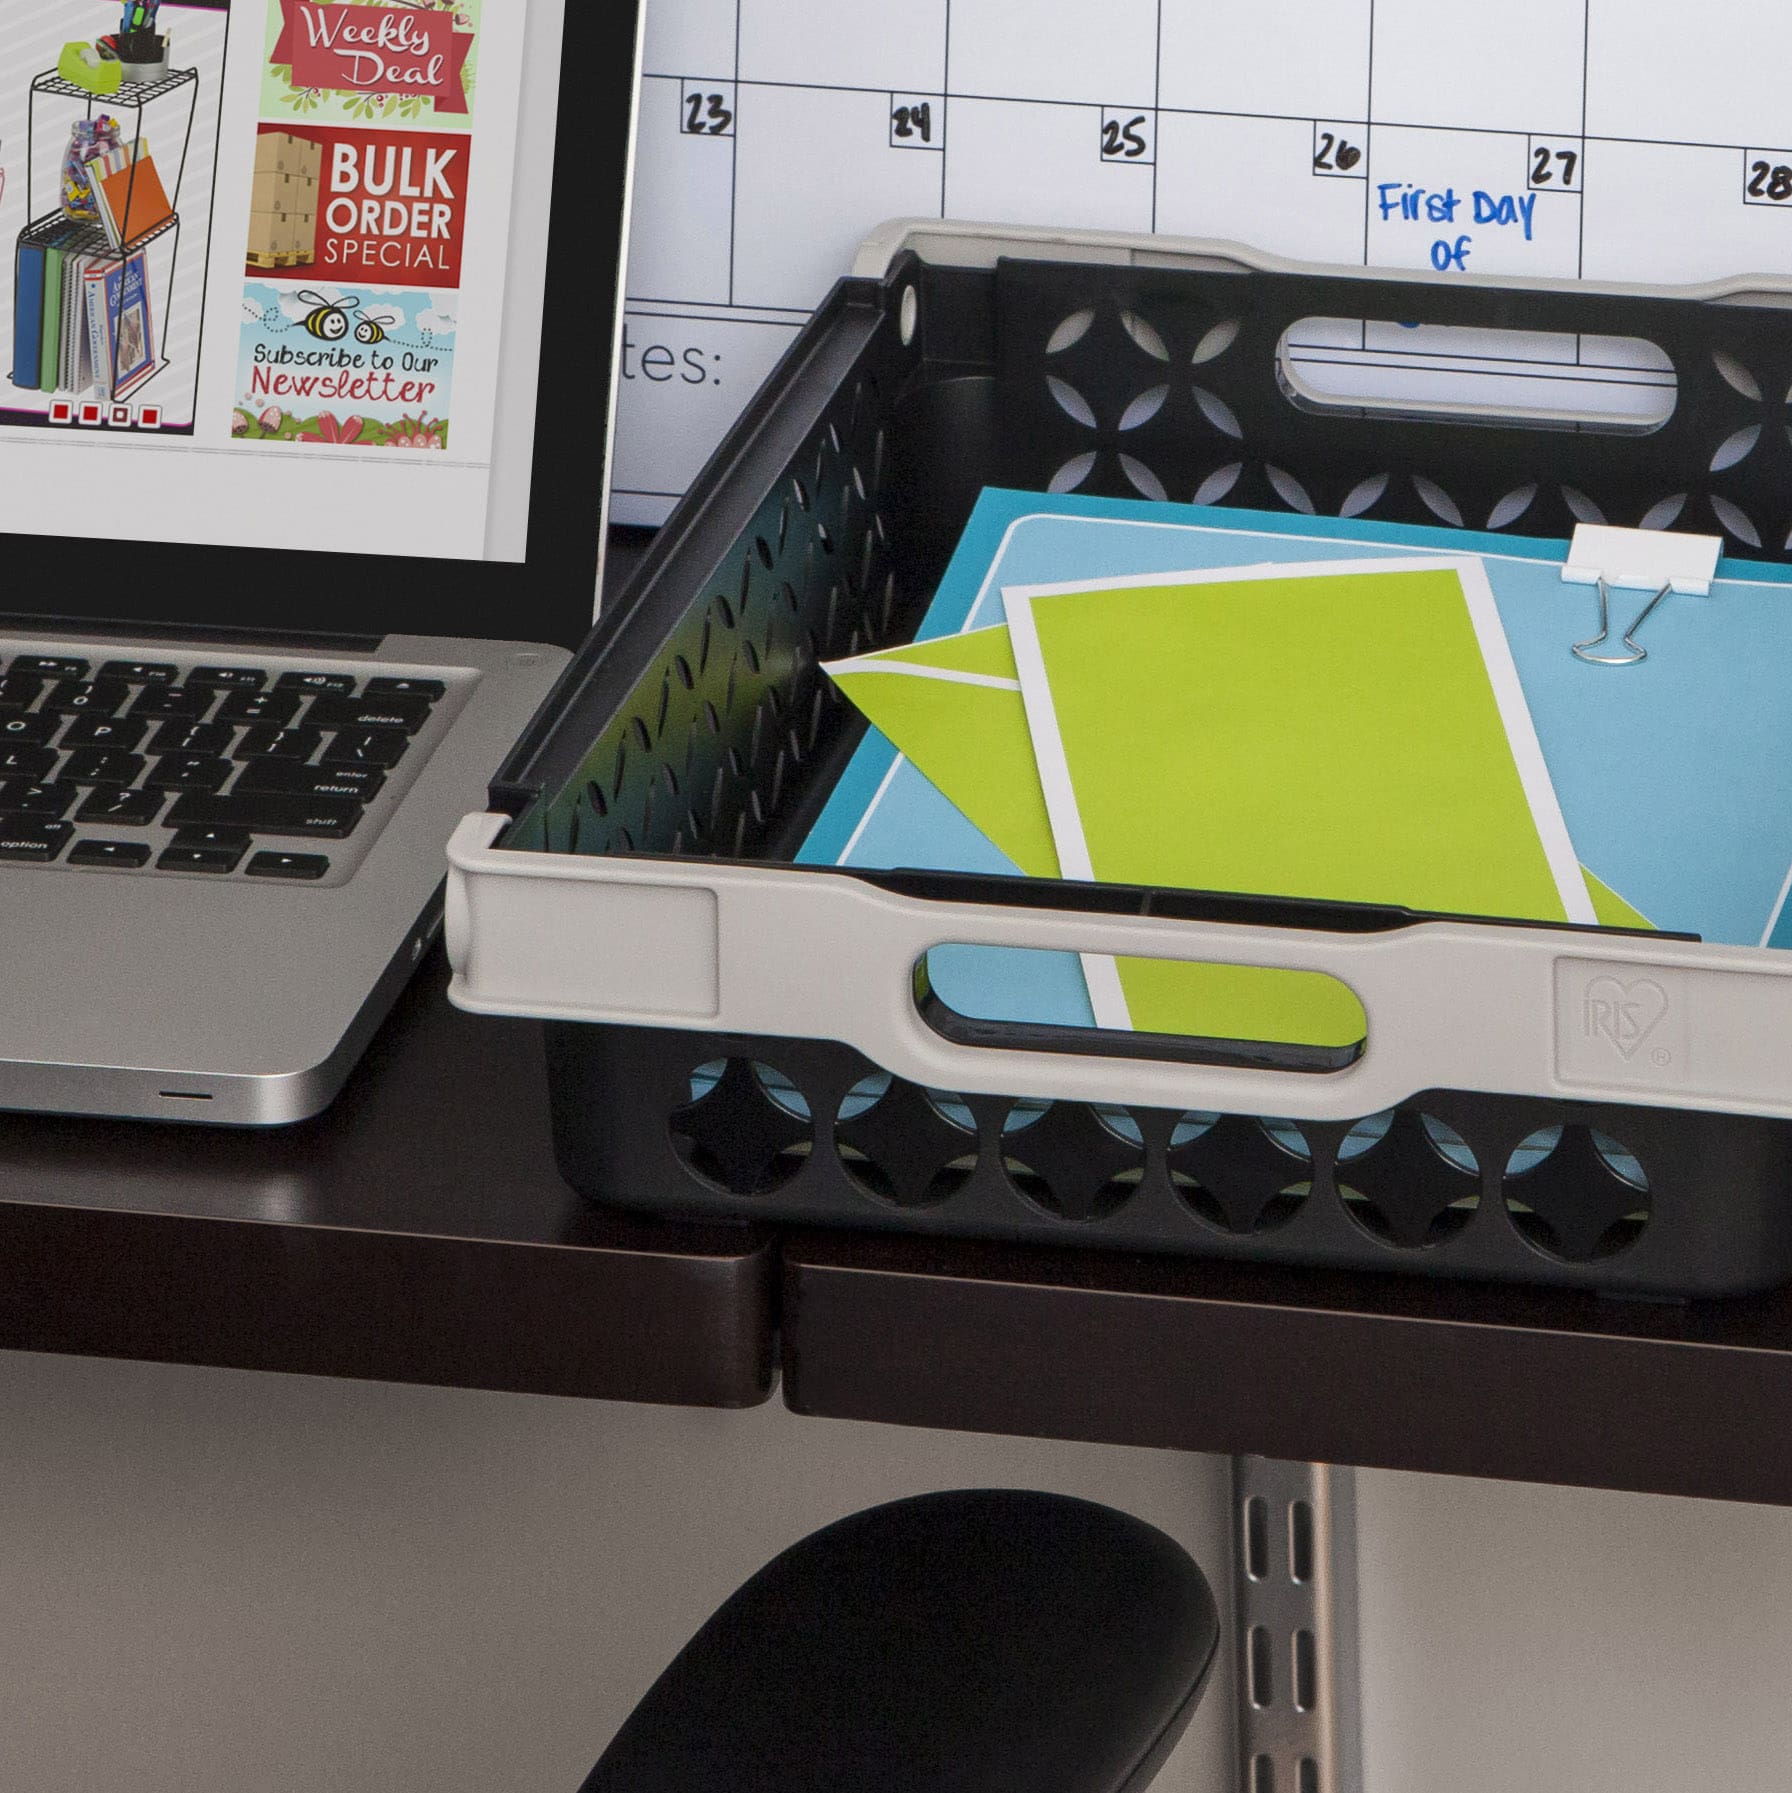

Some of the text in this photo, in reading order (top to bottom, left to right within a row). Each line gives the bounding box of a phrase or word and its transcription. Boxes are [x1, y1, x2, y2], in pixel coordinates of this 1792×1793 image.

[300, 6, 430, 56] Weekly
[333, 48, 444, 86] Deal
[685, 93, 733, 133] 23
[892, 103, 930, 143] 24
[1101, 118, 1146, 159] 25
[1313, 134, 1361, 170] 26
[330, 142, 457, 199] BULK
[1531, 148, 1577, 186] 27
[325, 197, 452, 240] ORDER
[1377, 183, 1537, 241] First Day
[324, 239, 451, 271] SPECIAL
[253, 343, 438, 372] Subscribe to Our
[622, 323, 720, 384] tes:
[251, 365, 436, 404] Newsletter
[94, 726, 112, 736] P
[358, 714, 404, 724] delete
[6, 755, 18, 765] L
[313, 784, 359, 794] return
[306, 817, 337, 825] shift
[1, 841, 48, 849] option
